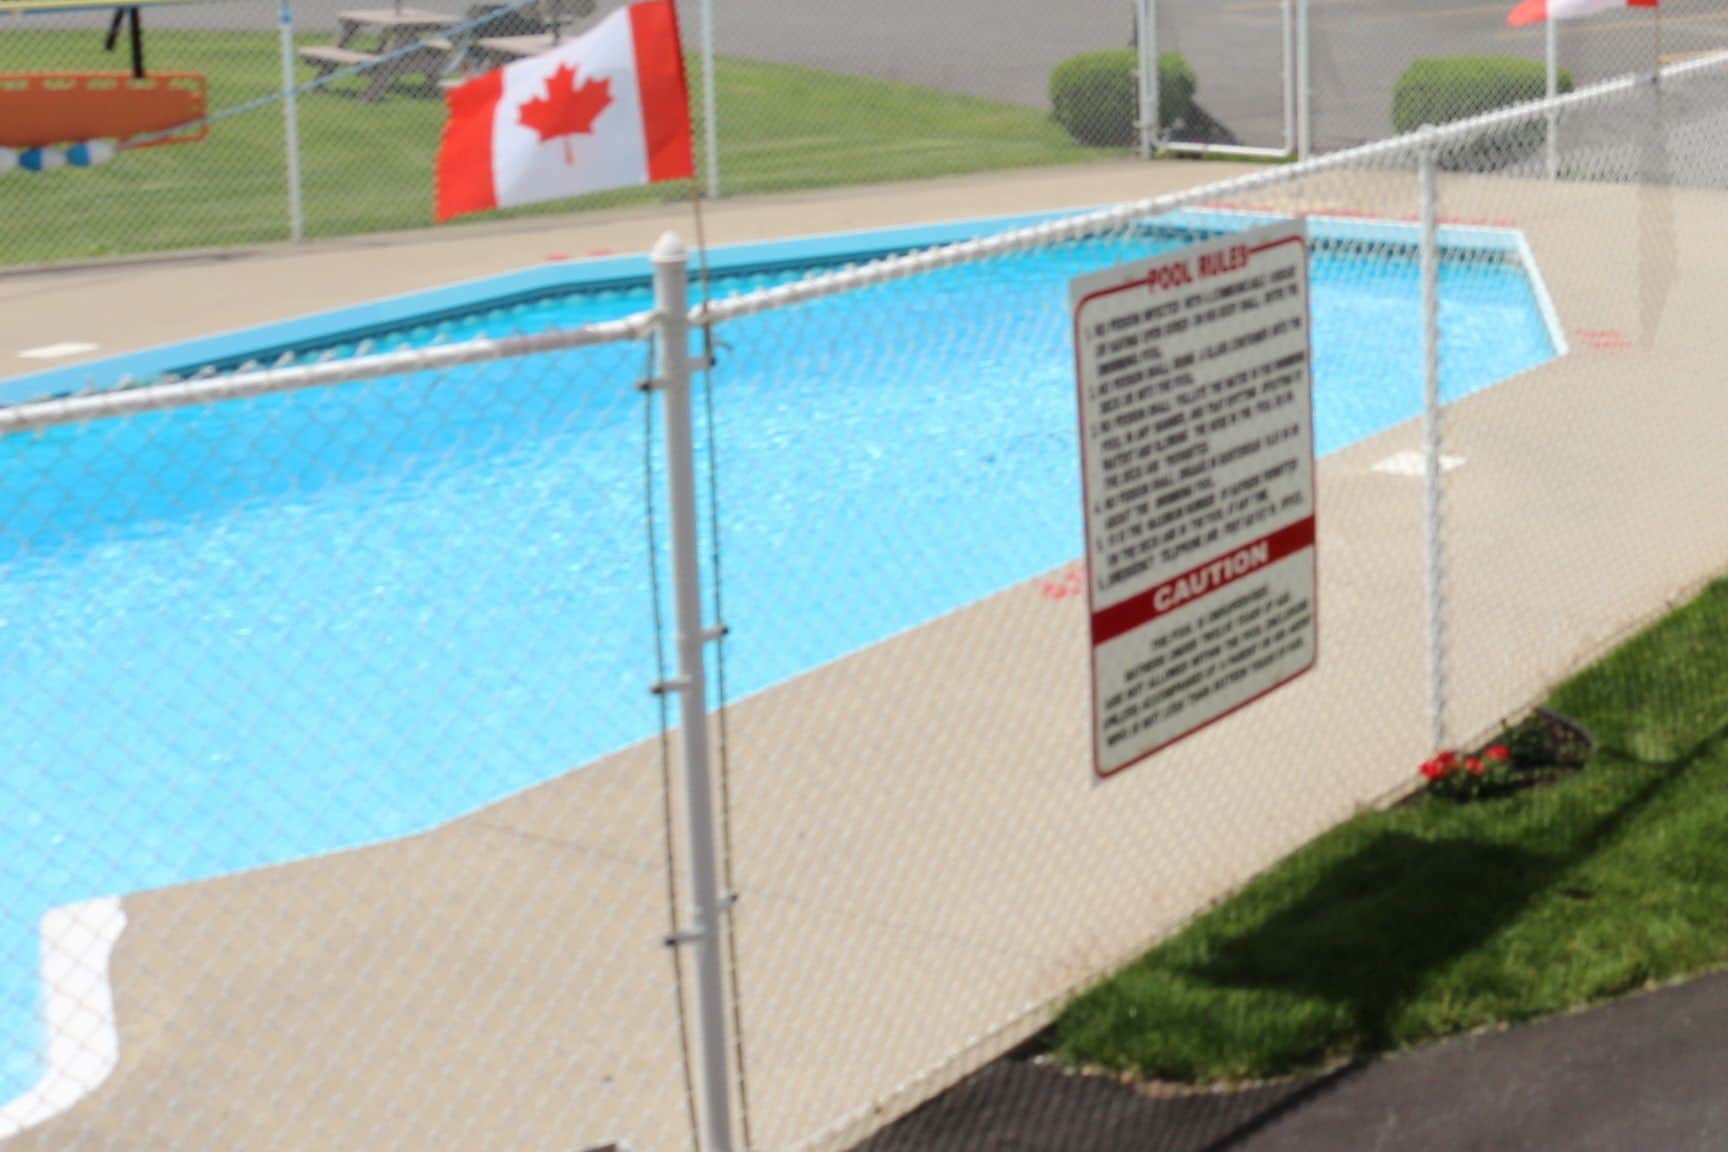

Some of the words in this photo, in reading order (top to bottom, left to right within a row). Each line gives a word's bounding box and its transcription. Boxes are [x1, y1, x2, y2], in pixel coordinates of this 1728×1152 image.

[1148, 260, 1193, 294] POOL
[1198, 243, 1249, 278] RULES
[1153, 540, 1269, 612] CAUTION
